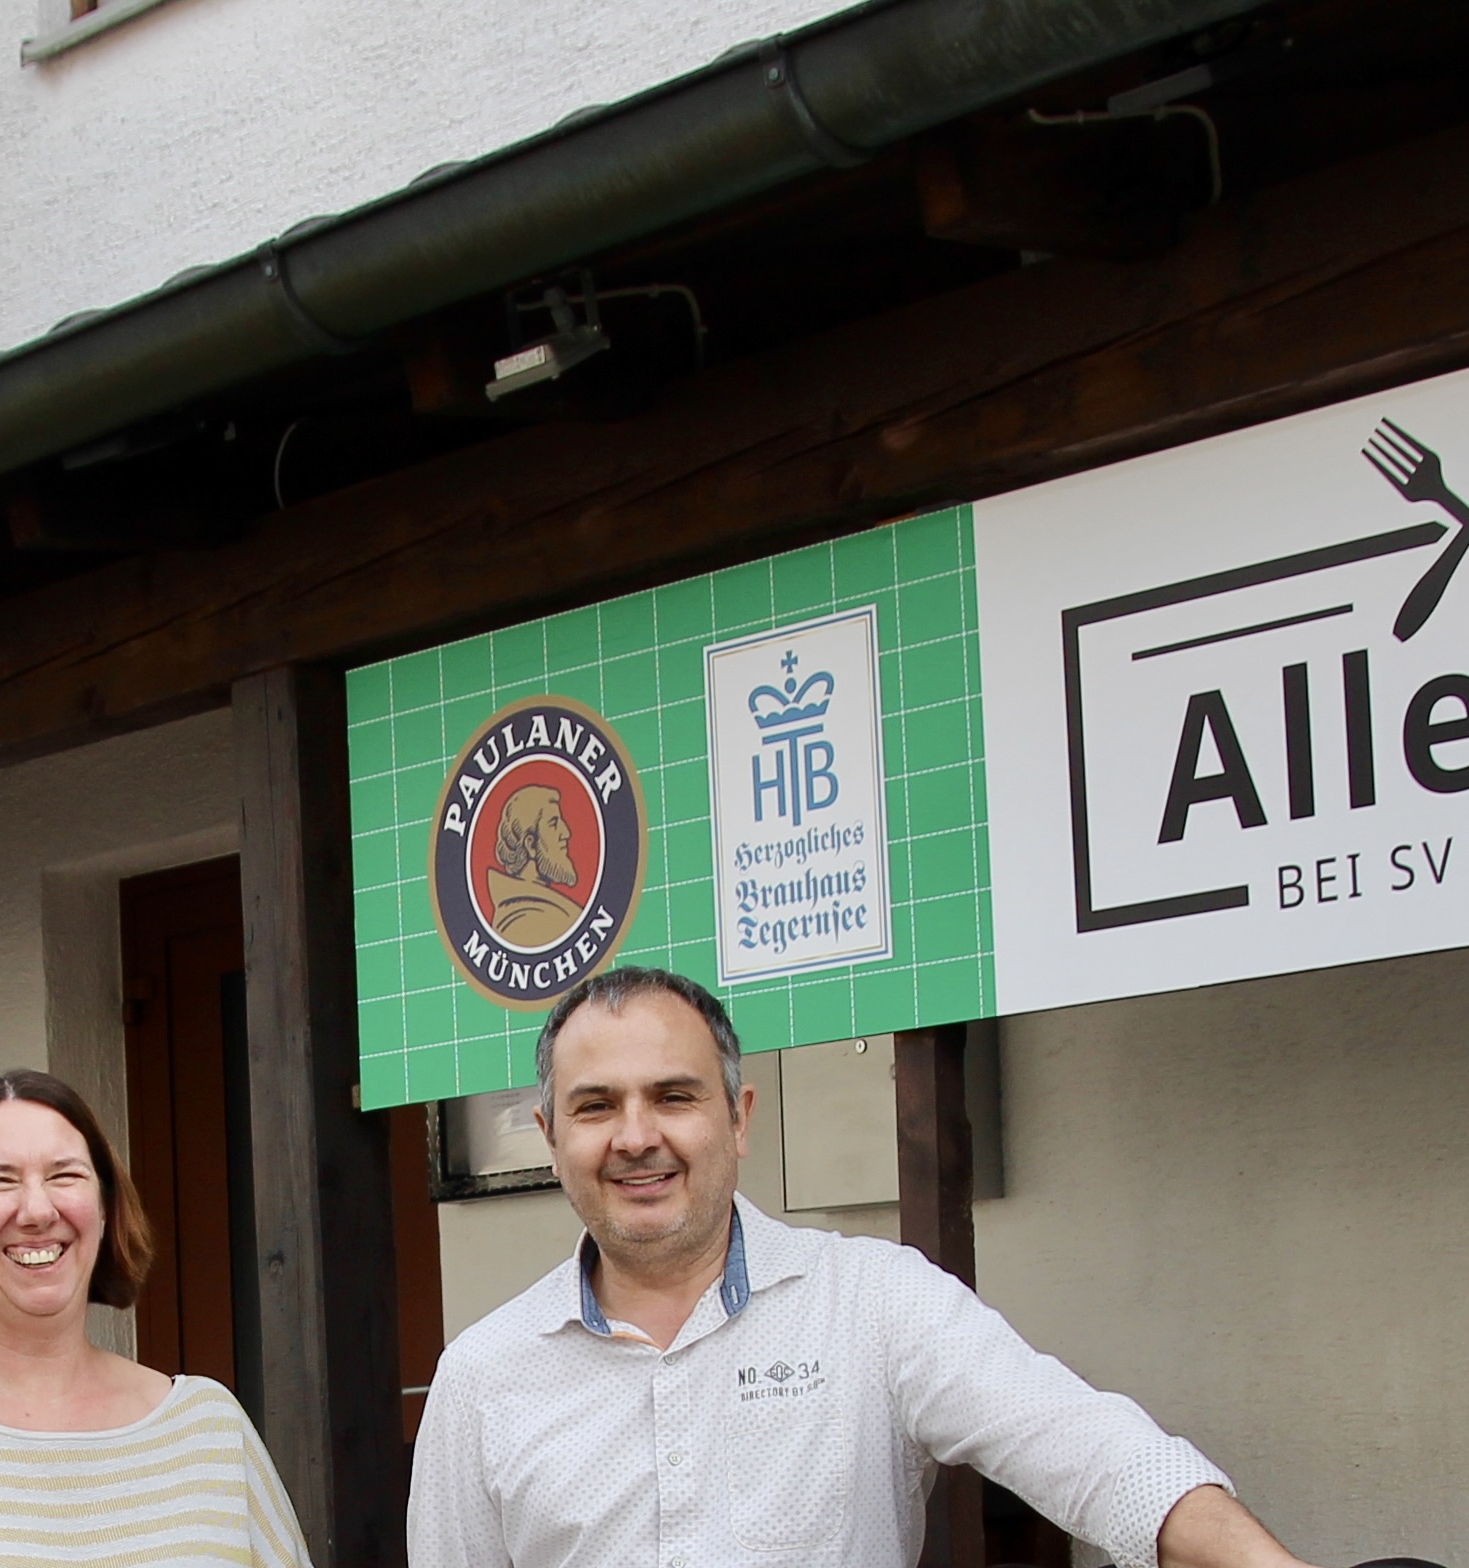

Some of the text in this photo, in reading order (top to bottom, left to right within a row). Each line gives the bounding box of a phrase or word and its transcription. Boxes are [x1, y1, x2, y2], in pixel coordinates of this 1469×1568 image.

[444, 714, 623, 837] PAULANER
[734, 821, 865, 875] Herzogliches
[1276, 852, 1364, 910] BEI
[1389, 837, 1454, 892] SV
[735, 860, 867, 913] Brauhaus
[462, 905, 616, 991] MÜNCHEN
